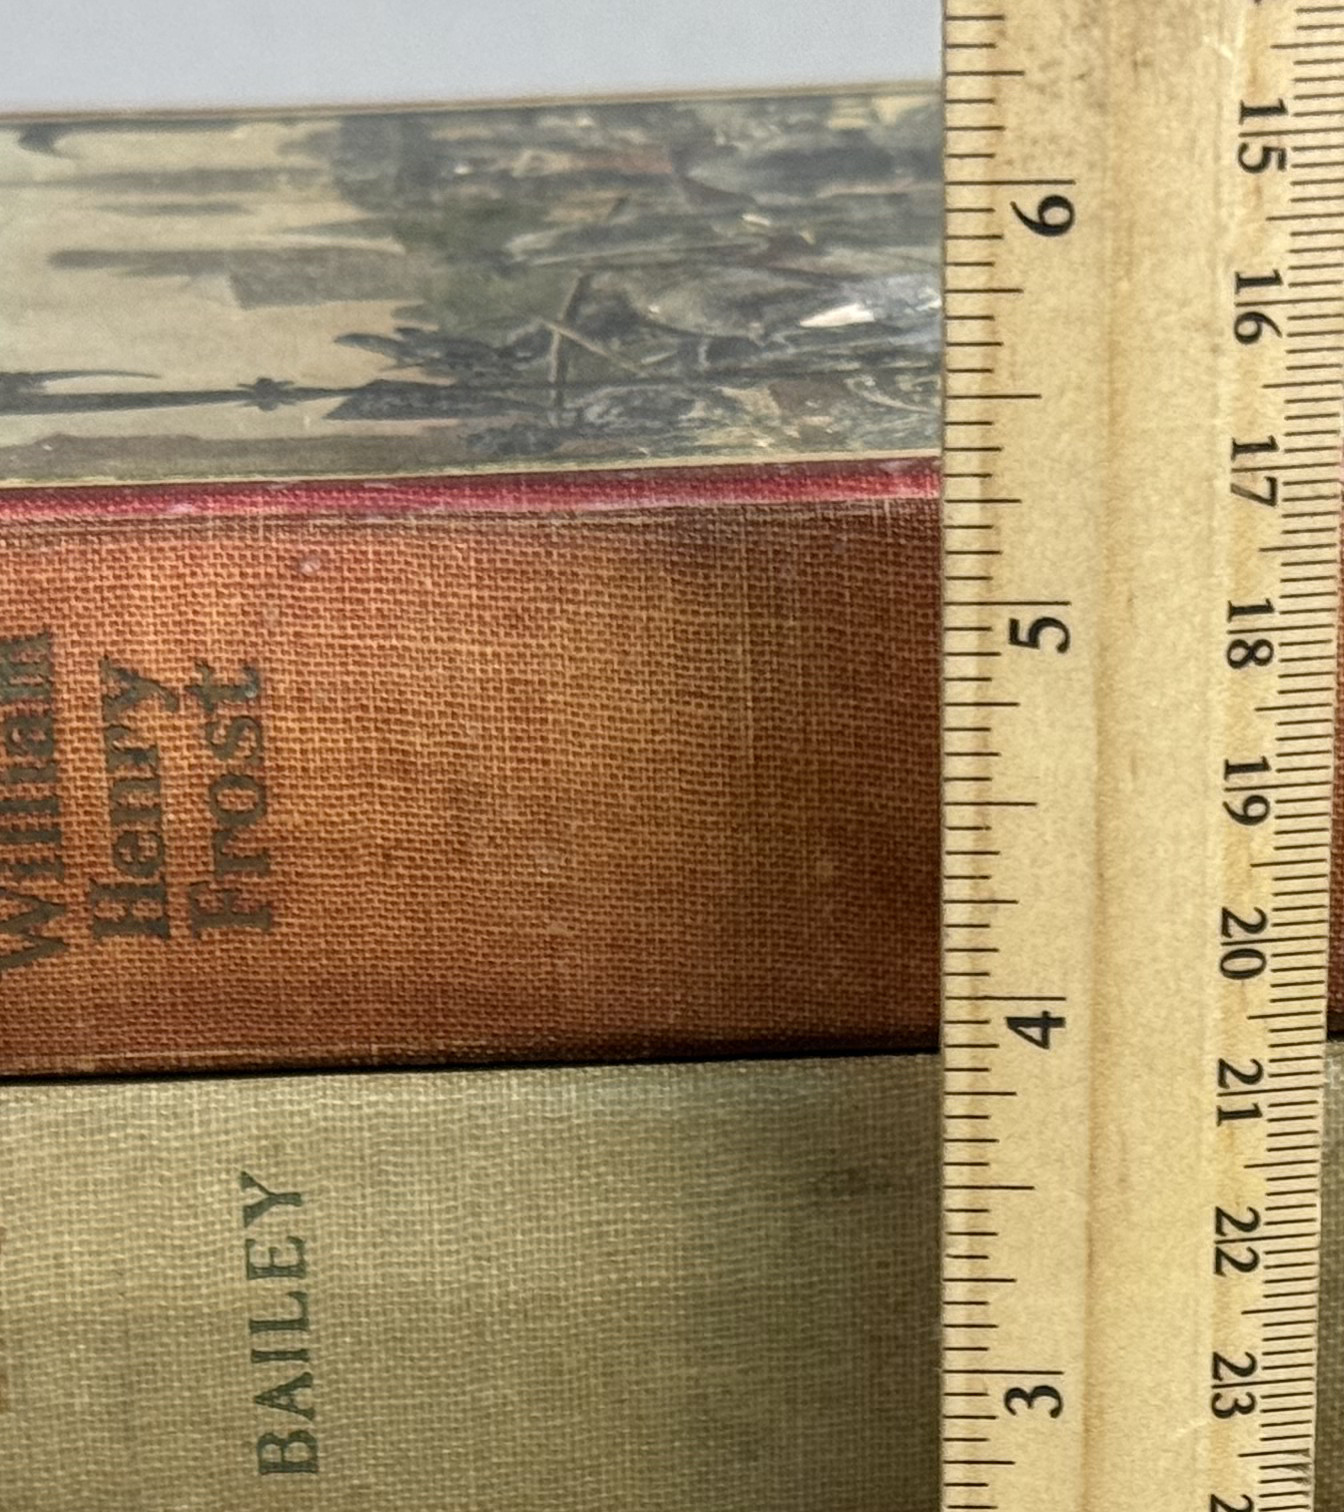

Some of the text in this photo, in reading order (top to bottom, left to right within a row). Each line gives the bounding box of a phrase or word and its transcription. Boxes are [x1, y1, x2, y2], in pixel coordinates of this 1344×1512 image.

[1237, 98, 1288, 174] 15
[1010, 195, 1075, 237] 6
[1233, 269, 1282, 344] 16
[1230, 435, 1280, 508] 17
[1009, 617, 1071, 653] 5
[1226, 598, 1275, 669] 18
[88, 655, 179, 940] Henry
[184, 659, 273, 938] Frost
[1223, 756, 1271, 825] 19
[1219, 907, 1268, 980] 20
[1006, 1010, 1066, 1050] 4
[1216, 1059, 1264, 1127] 21
[1213, 1207, 1261, 1277] 22
[238, 1169, 320, 1478] BAILEY
[1003, 1385, 1064, 1418] 3
[1211, 1352, 1257, 1419] 23
